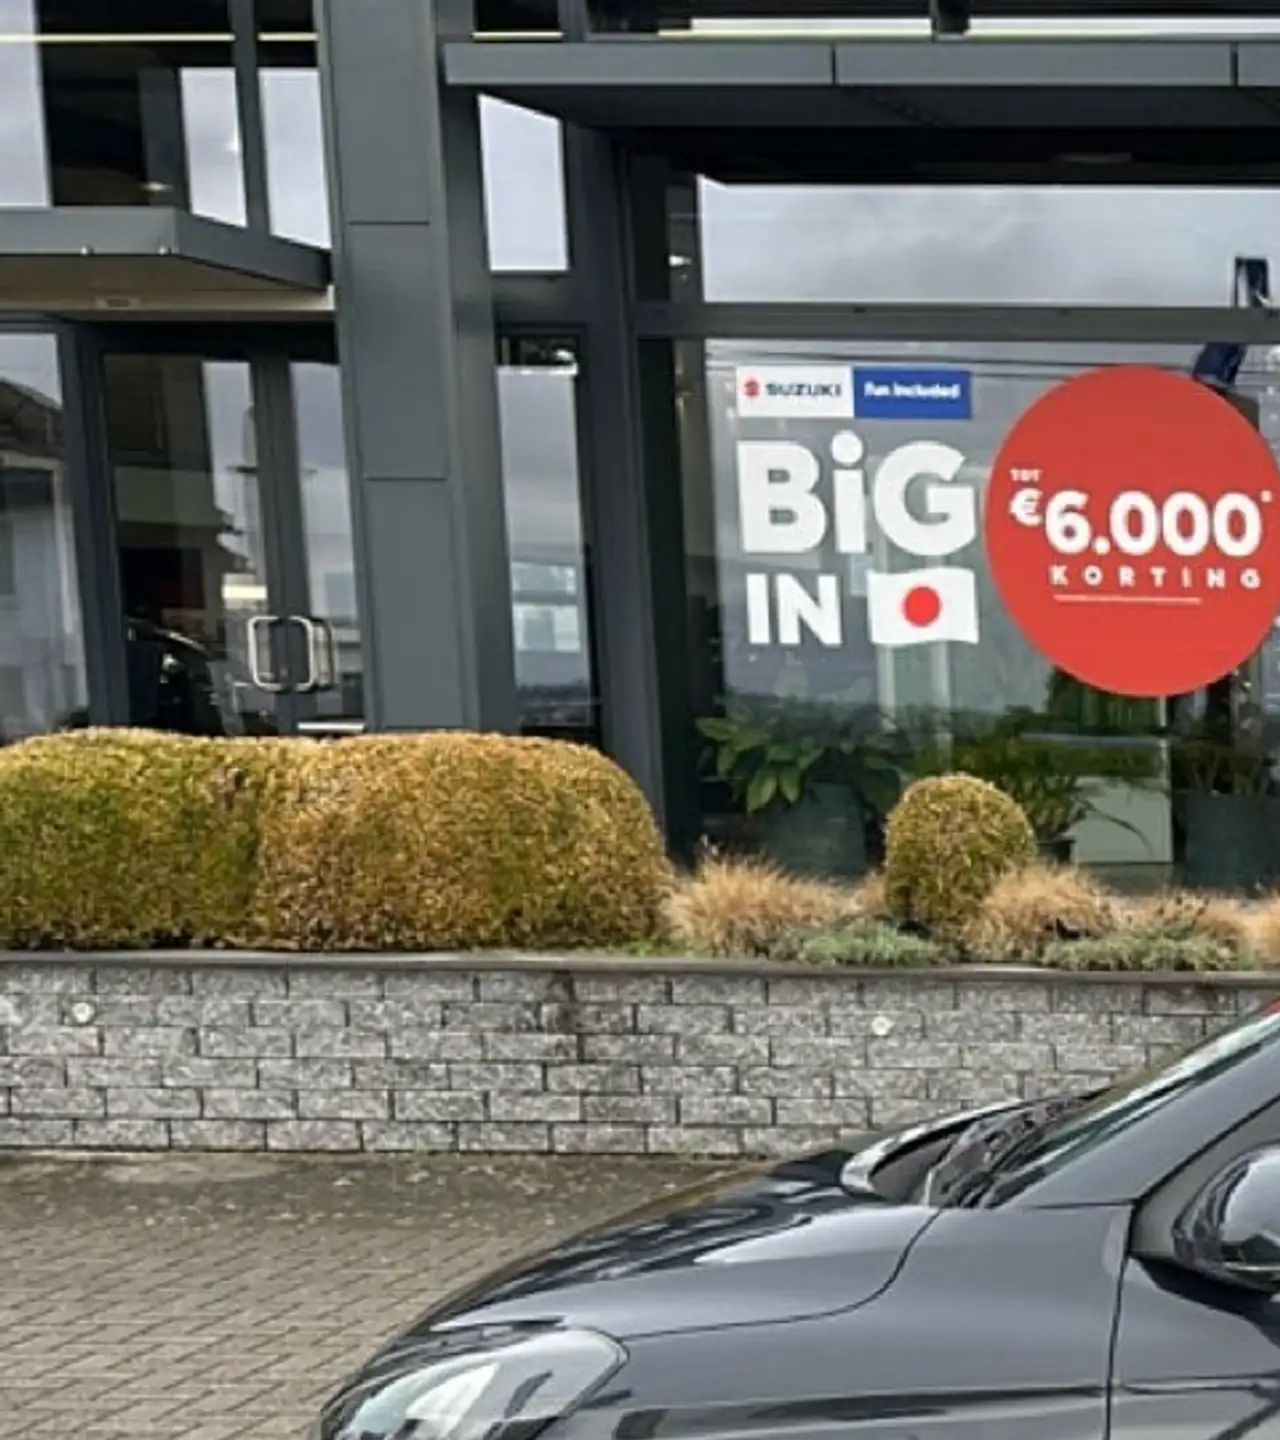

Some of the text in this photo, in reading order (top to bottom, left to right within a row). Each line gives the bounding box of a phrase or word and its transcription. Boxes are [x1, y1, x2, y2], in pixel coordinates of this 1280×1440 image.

[766, 383, 842, 397] SUZUKI
[1051, 564, 1261, 589] KORTING
[746, 574, 843, 646] IN
